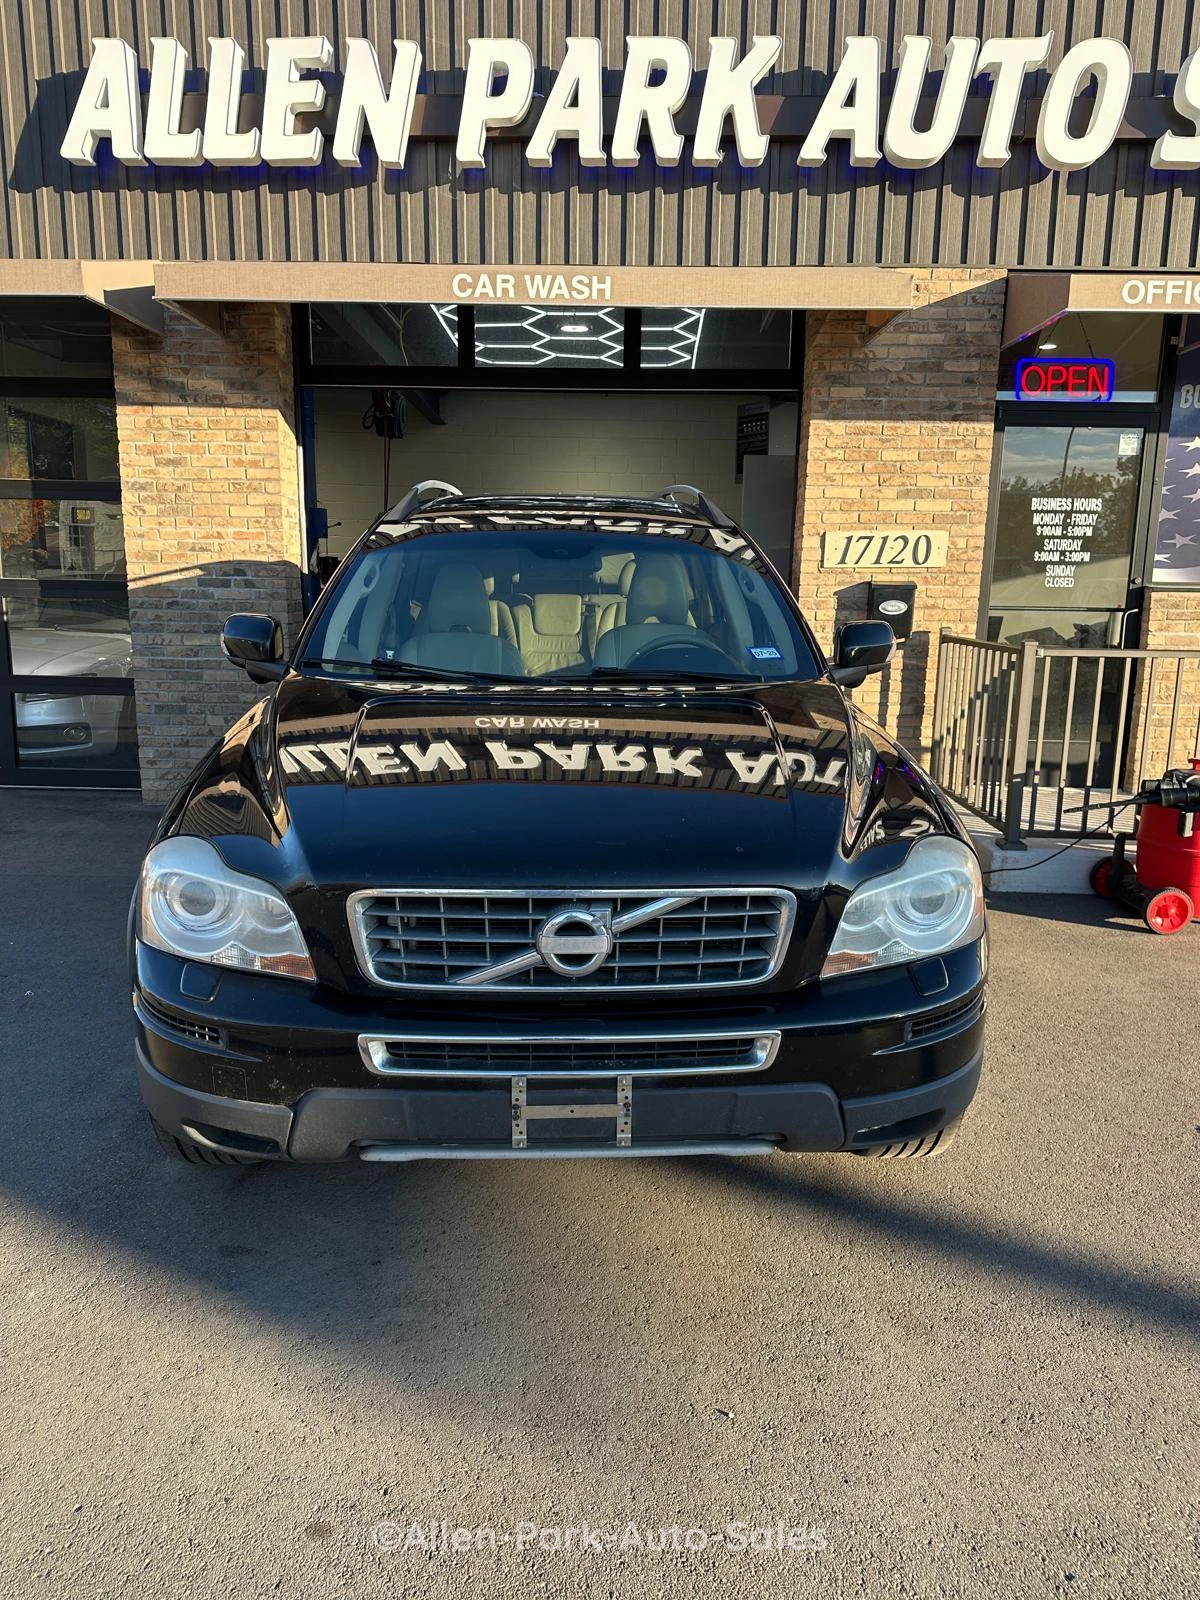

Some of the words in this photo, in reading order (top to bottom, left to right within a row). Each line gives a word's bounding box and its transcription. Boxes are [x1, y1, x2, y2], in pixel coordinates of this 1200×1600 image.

[61, 36, 423, 169] ALLEN
[456, 35, 782, 169] PARK
[797, 30, 1134, 172] AUTO
[452, 273, 516, 298] CAR
[524, 274, 612, 300] WASH
[1021, 365, 1109, 397] OPEN
[1031, 497, 1072, 511] BUSINESS
[1073, 498, 1103, 511] HOURS
[1033, 513, 1065, 525] MONDAY
[1071, 513, 1098, 526] FRIDAY
[1067, 526, 1093, 537] 5:00PM
[835, 534, 932, 565] 17120
[1043, 538, 1083, 551] SATURDAY
[1034, 551, 1060, 562] 9:00AM
[1065, 552, 1091, 562] 3:00PM
[1045, 564, 1076, 577] SUNDAY
[1045, 577, 1075, 588] CLOSED
